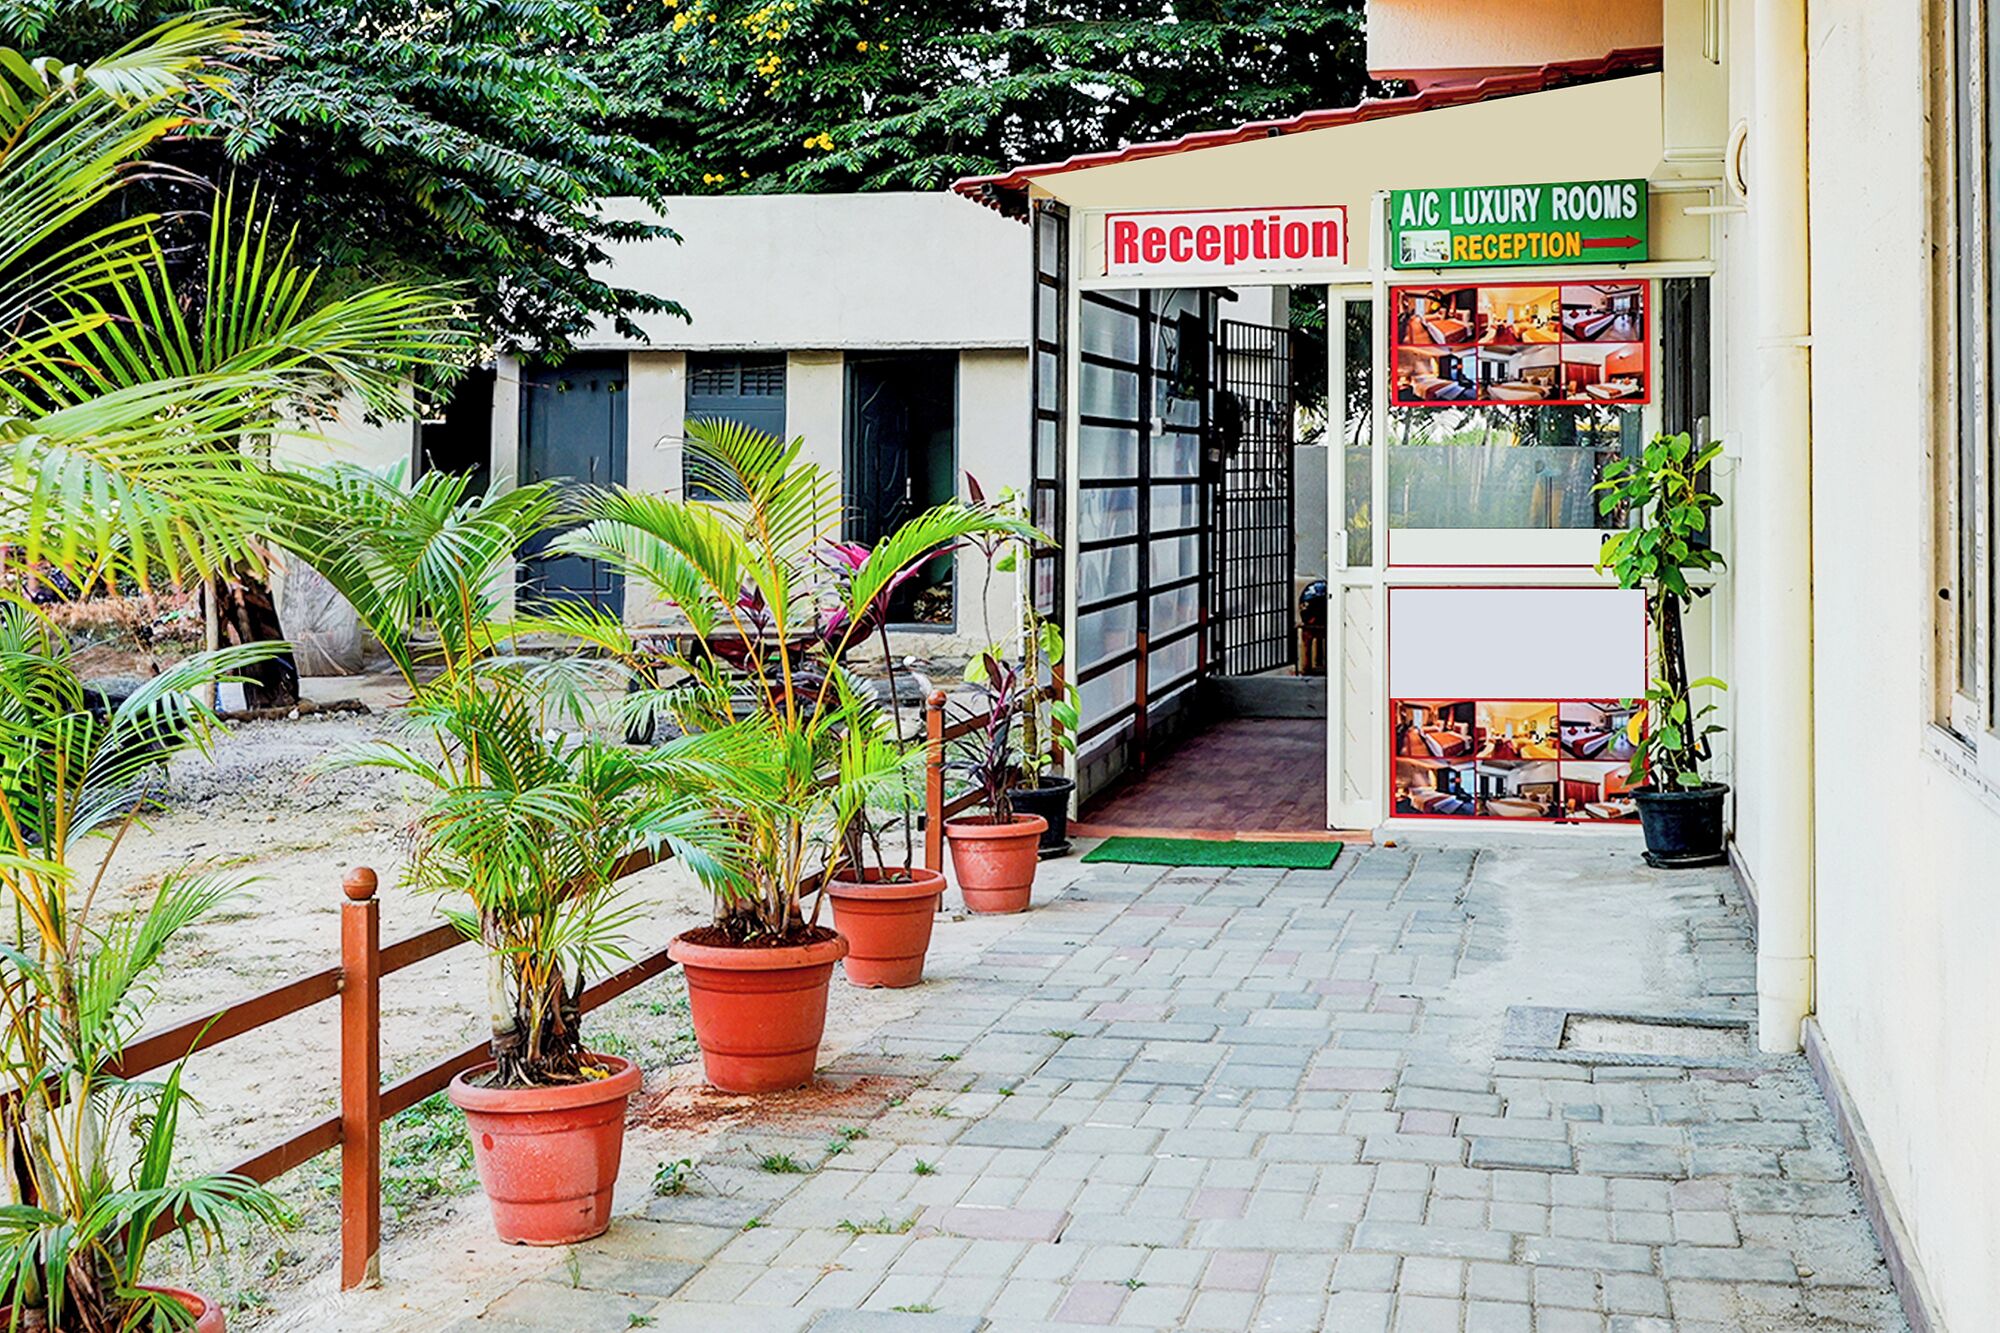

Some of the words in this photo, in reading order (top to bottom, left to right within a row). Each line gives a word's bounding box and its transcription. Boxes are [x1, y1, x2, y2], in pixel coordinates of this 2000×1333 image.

[1399, 190, 1441, 227] A/C
[1450, 187, 1541, 225] LUXURY
[1552, 183, 1638, 221] ROOMS
[1114, 215, 1338, 266] Reception
[1453, 231, 1581, 261] RECEPTION
